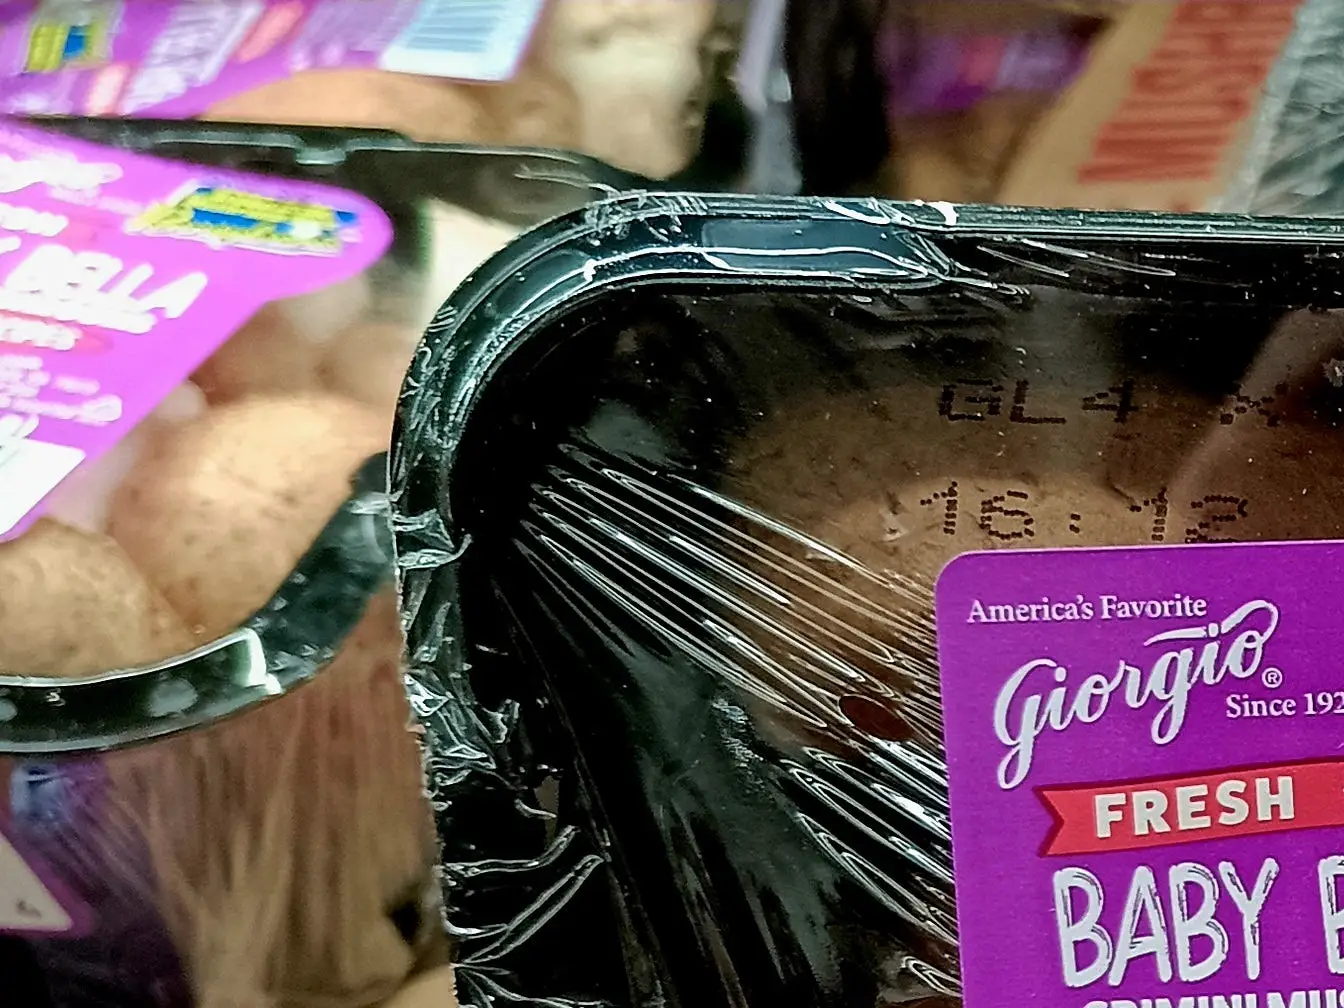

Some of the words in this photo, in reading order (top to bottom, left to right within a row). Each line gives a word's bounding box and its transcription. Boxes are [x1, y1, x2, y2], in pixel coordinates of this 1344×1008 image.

[967, 594, 1094, 624] America's
[1100, 594, 1207, 619] Favorite
[994, 599, 1279, 789] Giorgio
[1225, 694, 1296, 719] Since
[1094, 776, 1295, 838] FRESH
[1053, 857, 1279, 988] BABY
